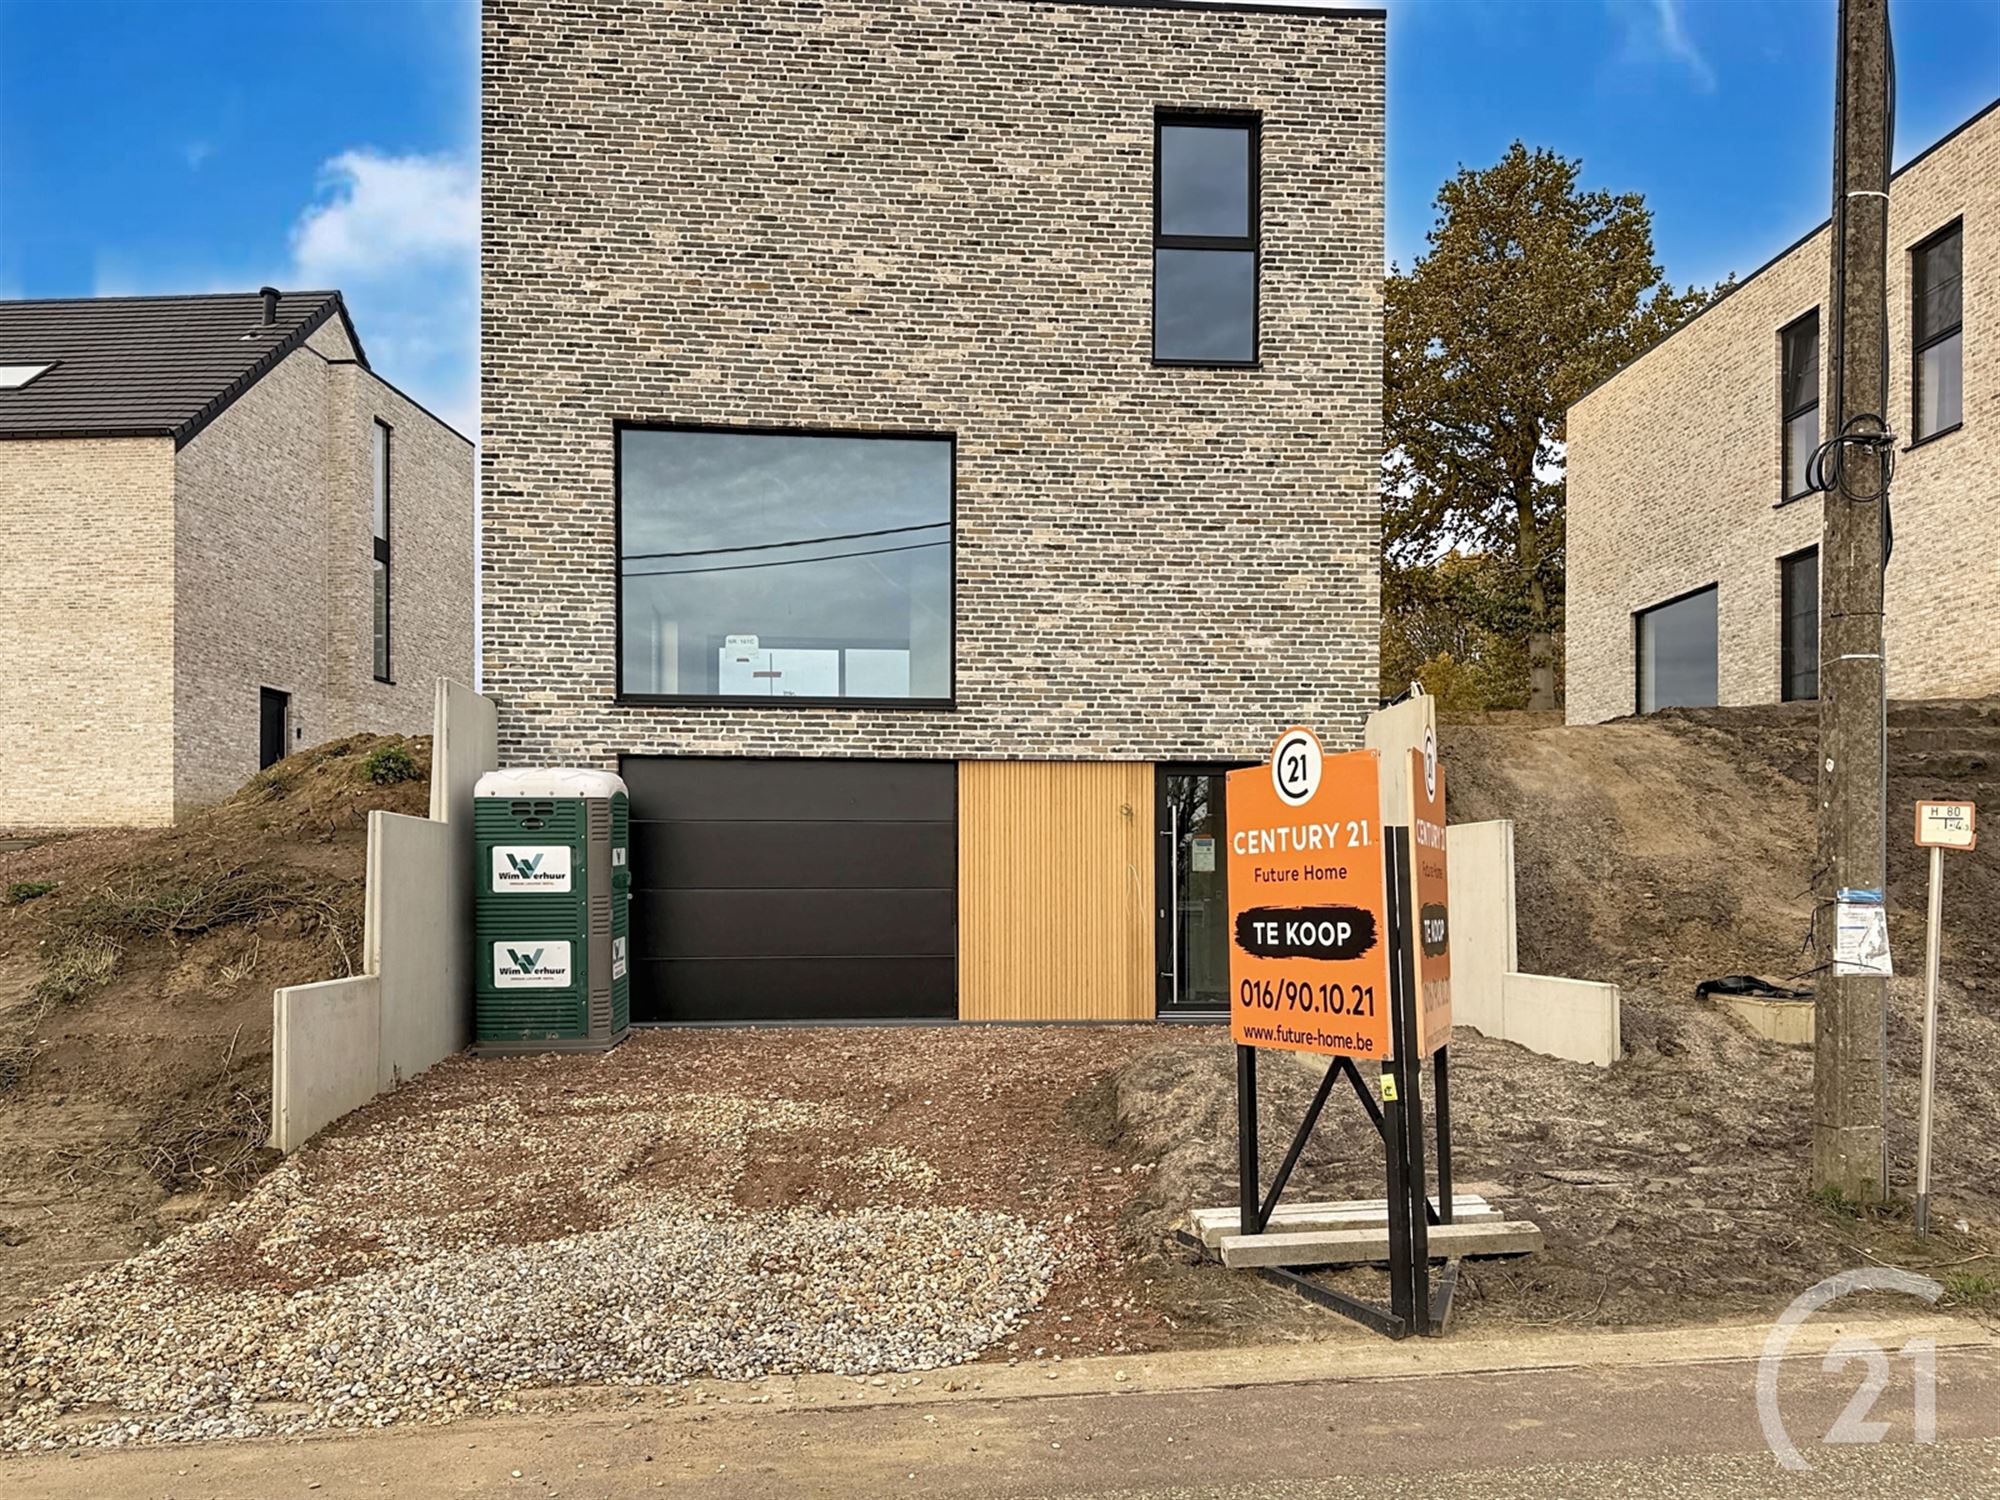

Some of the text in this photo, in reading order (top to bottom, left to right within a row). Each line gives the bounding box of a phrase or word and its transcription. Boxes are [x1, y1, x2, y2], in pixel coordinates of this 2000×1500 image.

[1930, 806, 1961, 817] H 80
[1233, 820, 1369, 855] CENTURY 21
[498, 872, 520, 880] Wim
[1254, 865, 1348, 883] Future Home
[1252, 921, 1352, 946] TE KOOP
[499, 967, 521, 975] Wim
[1240, 978, 1374, 1017] 016/90.10.21
[1244, 1024, 1373, 1051] www.future-home.be
